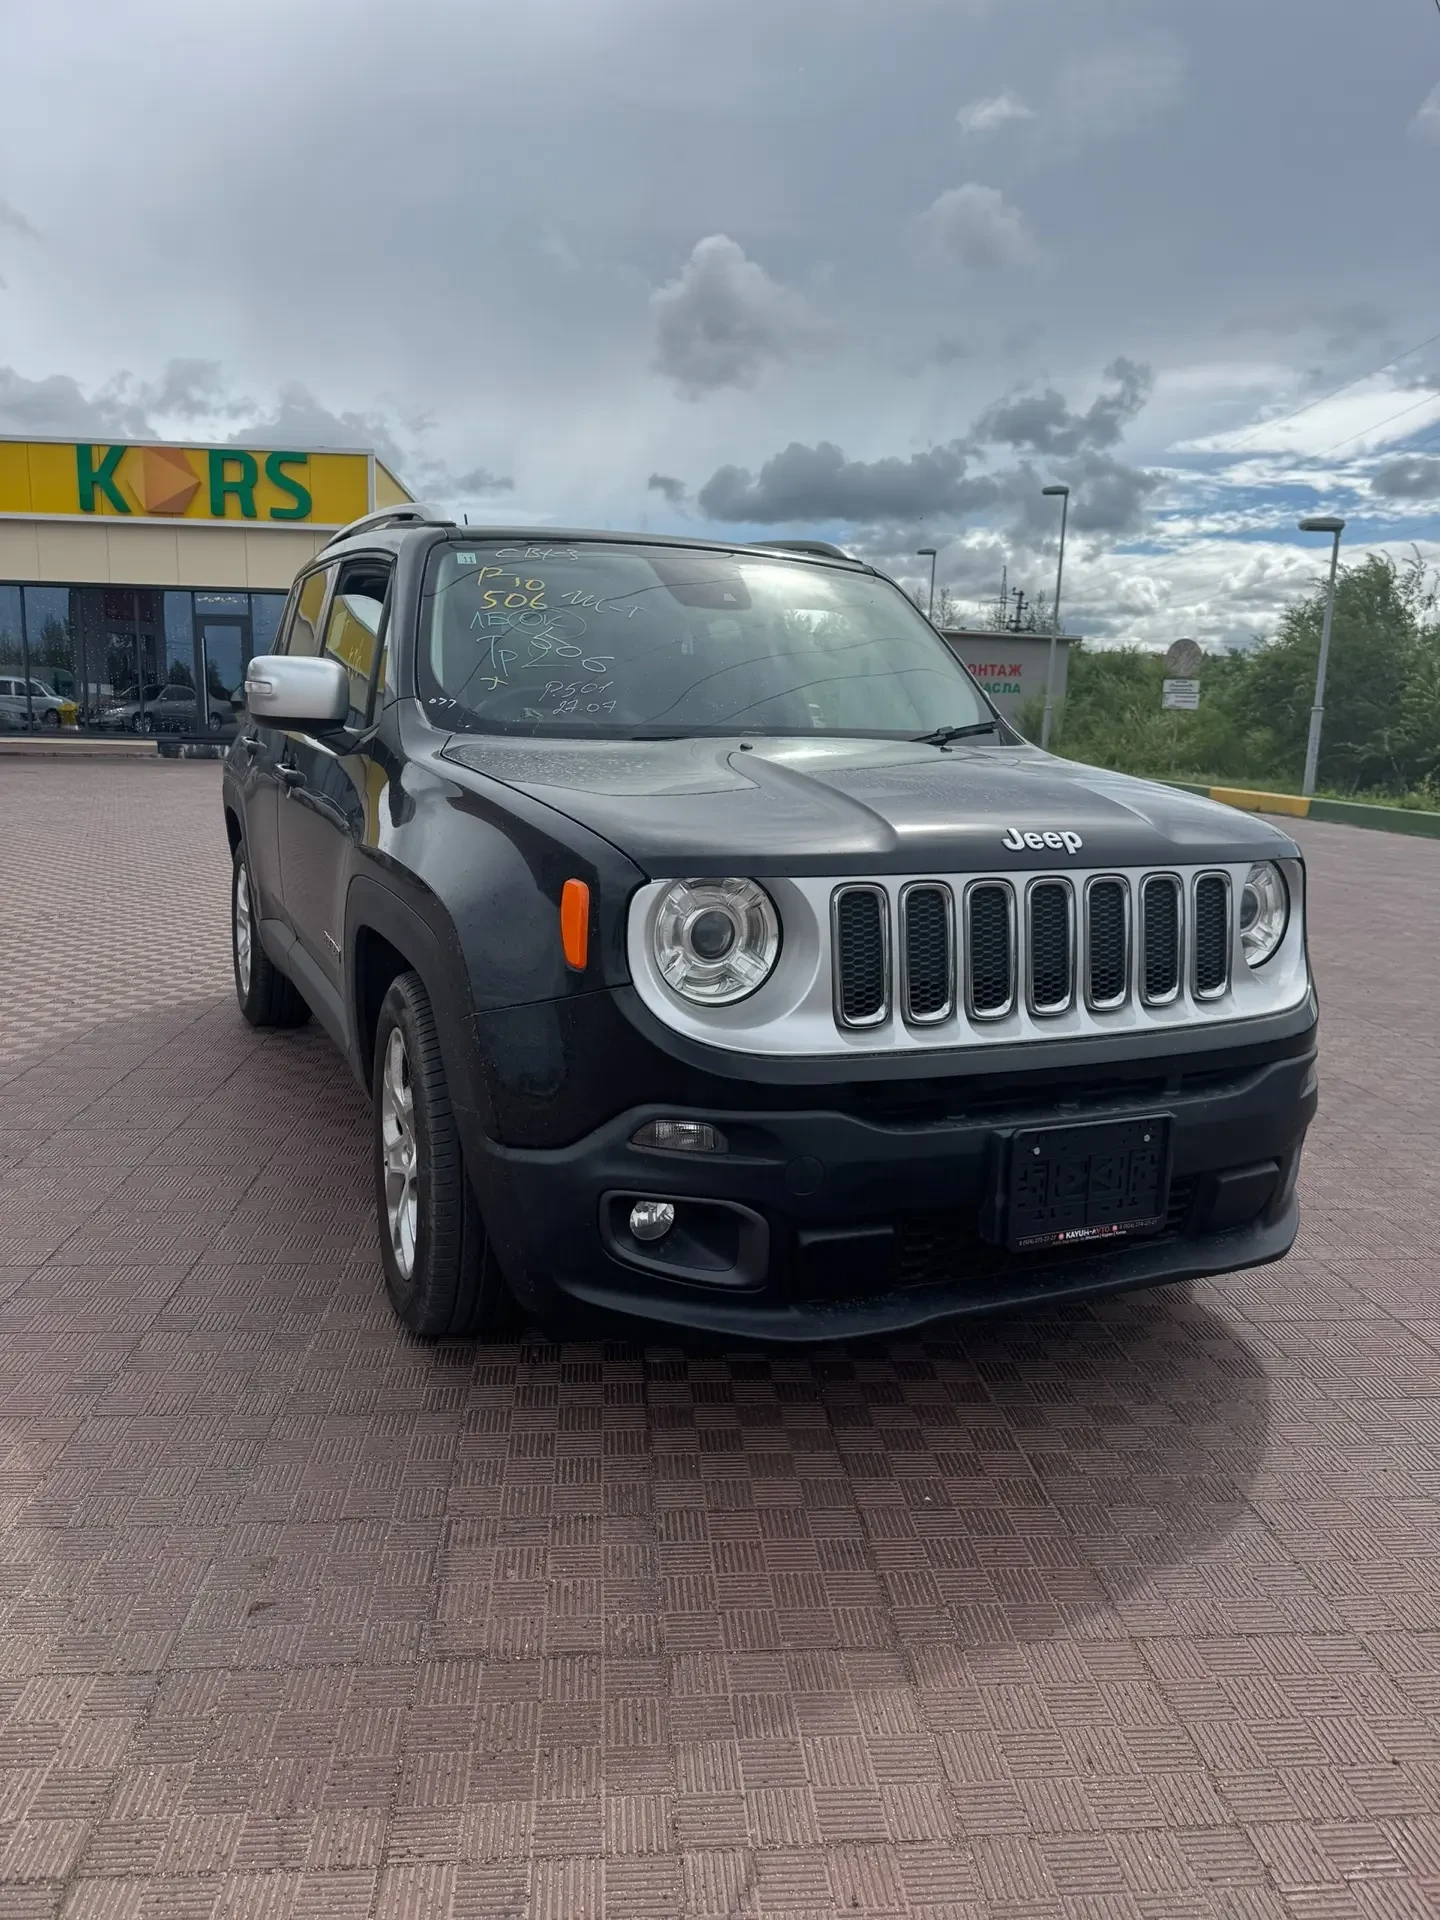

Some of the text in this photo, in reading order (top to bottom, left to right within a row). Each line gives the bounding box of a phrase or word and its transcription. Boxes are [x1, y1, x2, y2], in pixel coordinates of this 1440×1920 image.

[480, 590, 549, 611] 506
[967, 663, 1023, 677] ОНТАЖ
[978, 682, 1021, 694] АСЛА
[1000, 827, 1084, 856] Jeep
